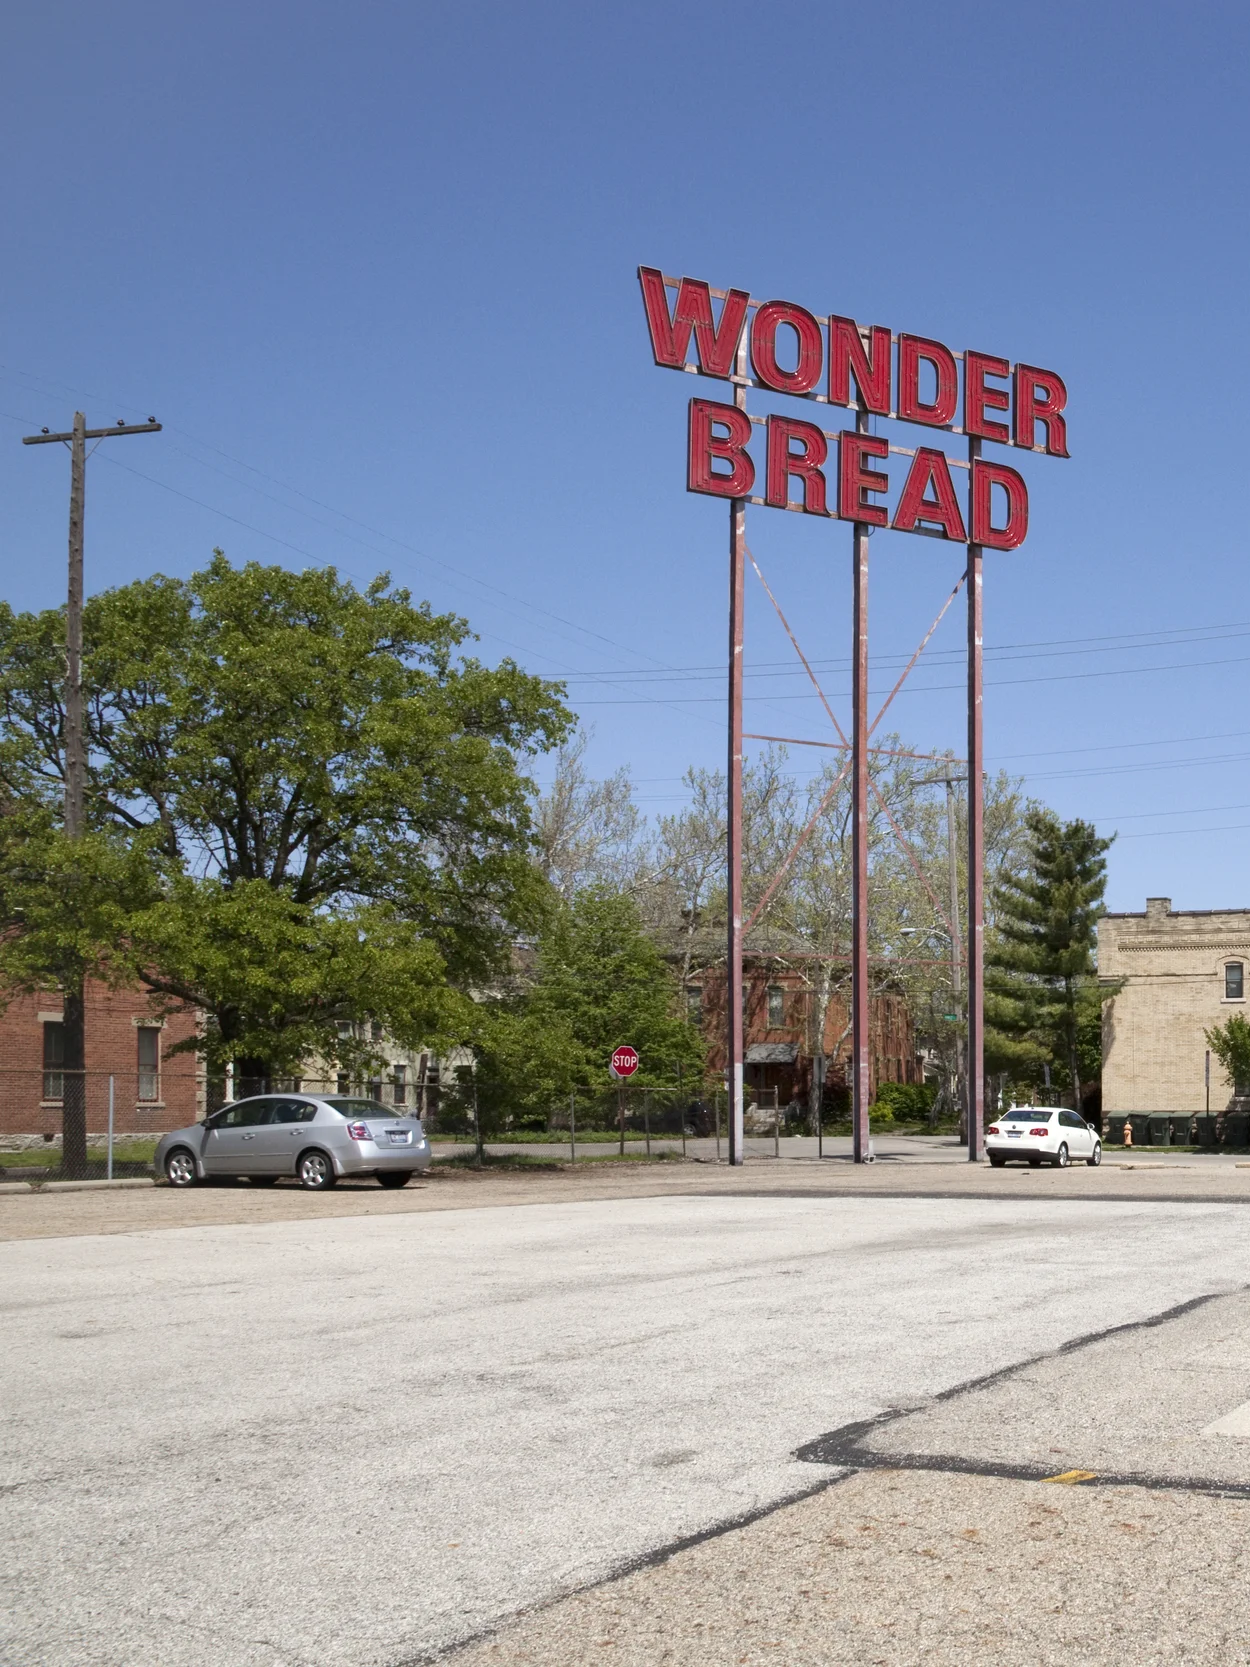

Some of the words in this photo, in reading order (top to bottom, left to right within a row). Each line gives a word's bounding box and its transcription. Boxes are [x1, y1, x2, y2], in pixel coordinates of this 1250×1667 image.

[638, 265, 1071, 458] WONDER
[687, 398, 1029, 552] BREAD
[613, 1055, 637, 1068] STOP
